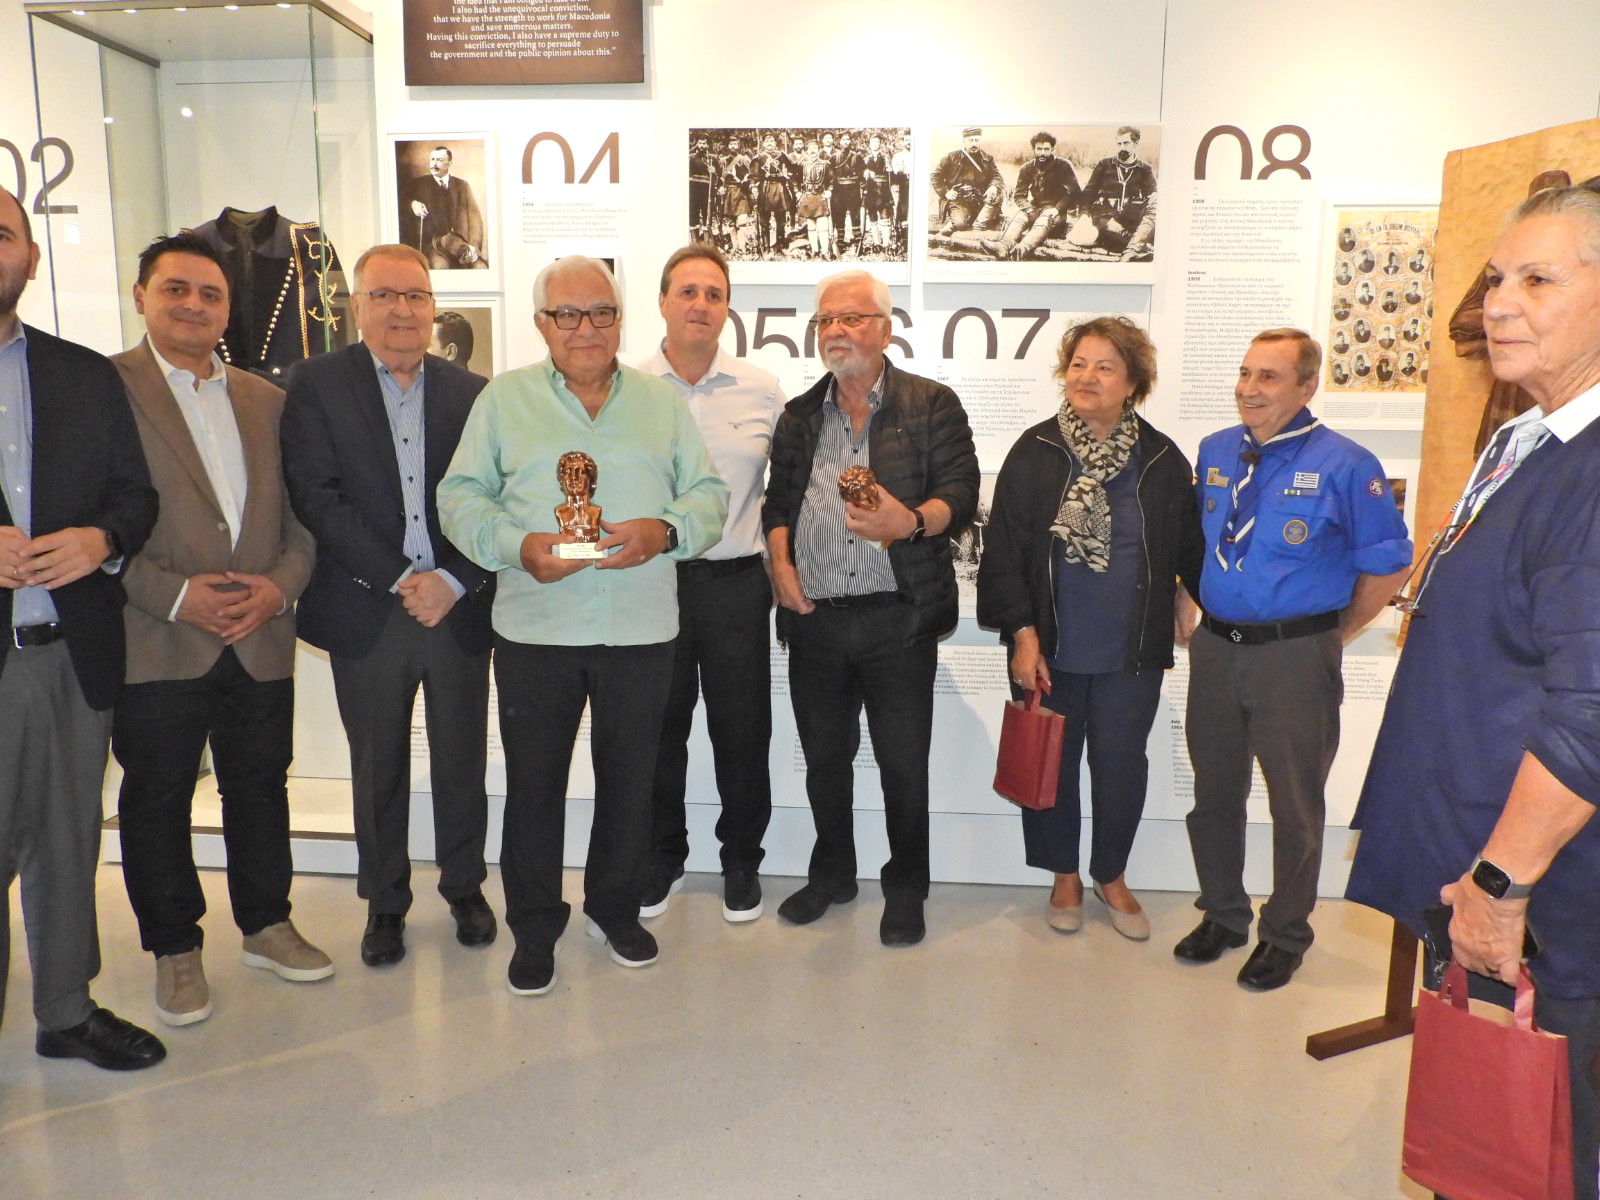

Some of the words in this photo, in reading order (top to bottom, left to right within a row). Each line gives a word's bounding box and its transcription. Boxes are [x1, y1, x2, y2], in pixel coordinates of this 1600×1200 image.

[457, 6, 472, 14] also
[474, 6, 487, 14] had
[490, 6, 501, 14] the
[503, 5, 548, 16] unequivocal
[550, 4, 592, 15] conviction,
[434, 16, 448, 24] that
[463, 15, 479, 23] have
[495, 14, 525, 25] strength
[528, 14, 535, 22] to
[557, 13, 568, 21] for
[570, 12, 612, 21] Macedonia
[471, 24, 484, 32] and
[543, 22, 574, 30] matters.
[427, 33, 452, 43] Having
[470, 32, 510, 42] conviction,
[535, 31, 551, 39] have
[560, 32, 591, 41] supreme
[593, 30, 610, 40] duty
[465, 42, 495, 50] sacrifice
[497, 41, 536, 51] everything
[548, 40, 582, 50] persuade
[431, 51, 442, 59] the
[444, 50, 487, 61] government
[490, 50, 503, 58] and
[506, 50, 517, 58] the
[519, 50, 541, 60] public
[544, 49, 571, 59] opinion
[596, 48, 617, 56] this."
[522, 131, 619, 184] 04
[1194, 124, 1312, 180] 08
[942, 307, 1051, 359] 07
